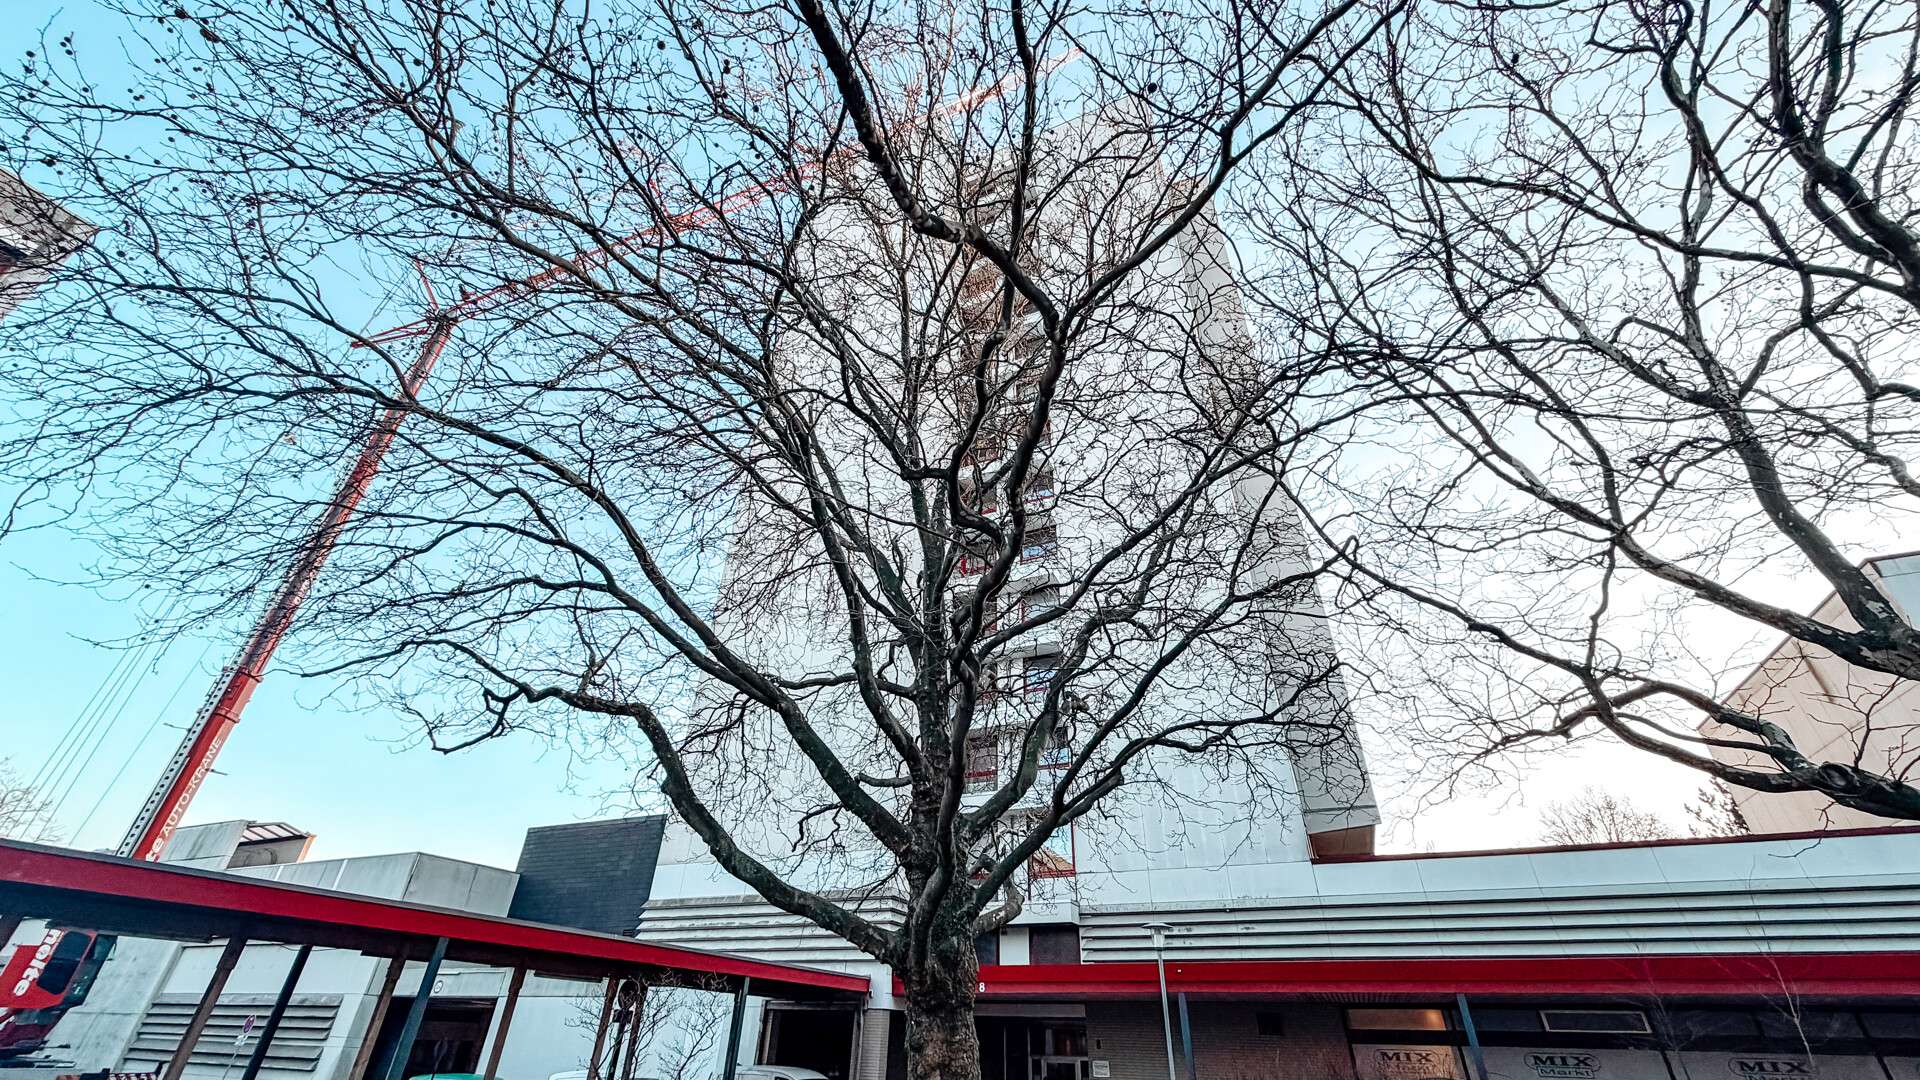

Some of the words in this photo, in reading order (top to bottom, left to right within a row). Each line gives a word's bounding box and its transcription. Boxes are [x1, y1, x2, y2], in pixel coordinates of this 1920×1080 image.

[13, 928, 62, 997] nolte
[979, 982, 985, 993] 8
[1380, 1051, 1433, 1063] MIX
[1530, 1055, 1594, 1067] MIX
[1540, 1068, 1592, 1077] Markt
[1736, 1060, 1811, 1074] MIX
